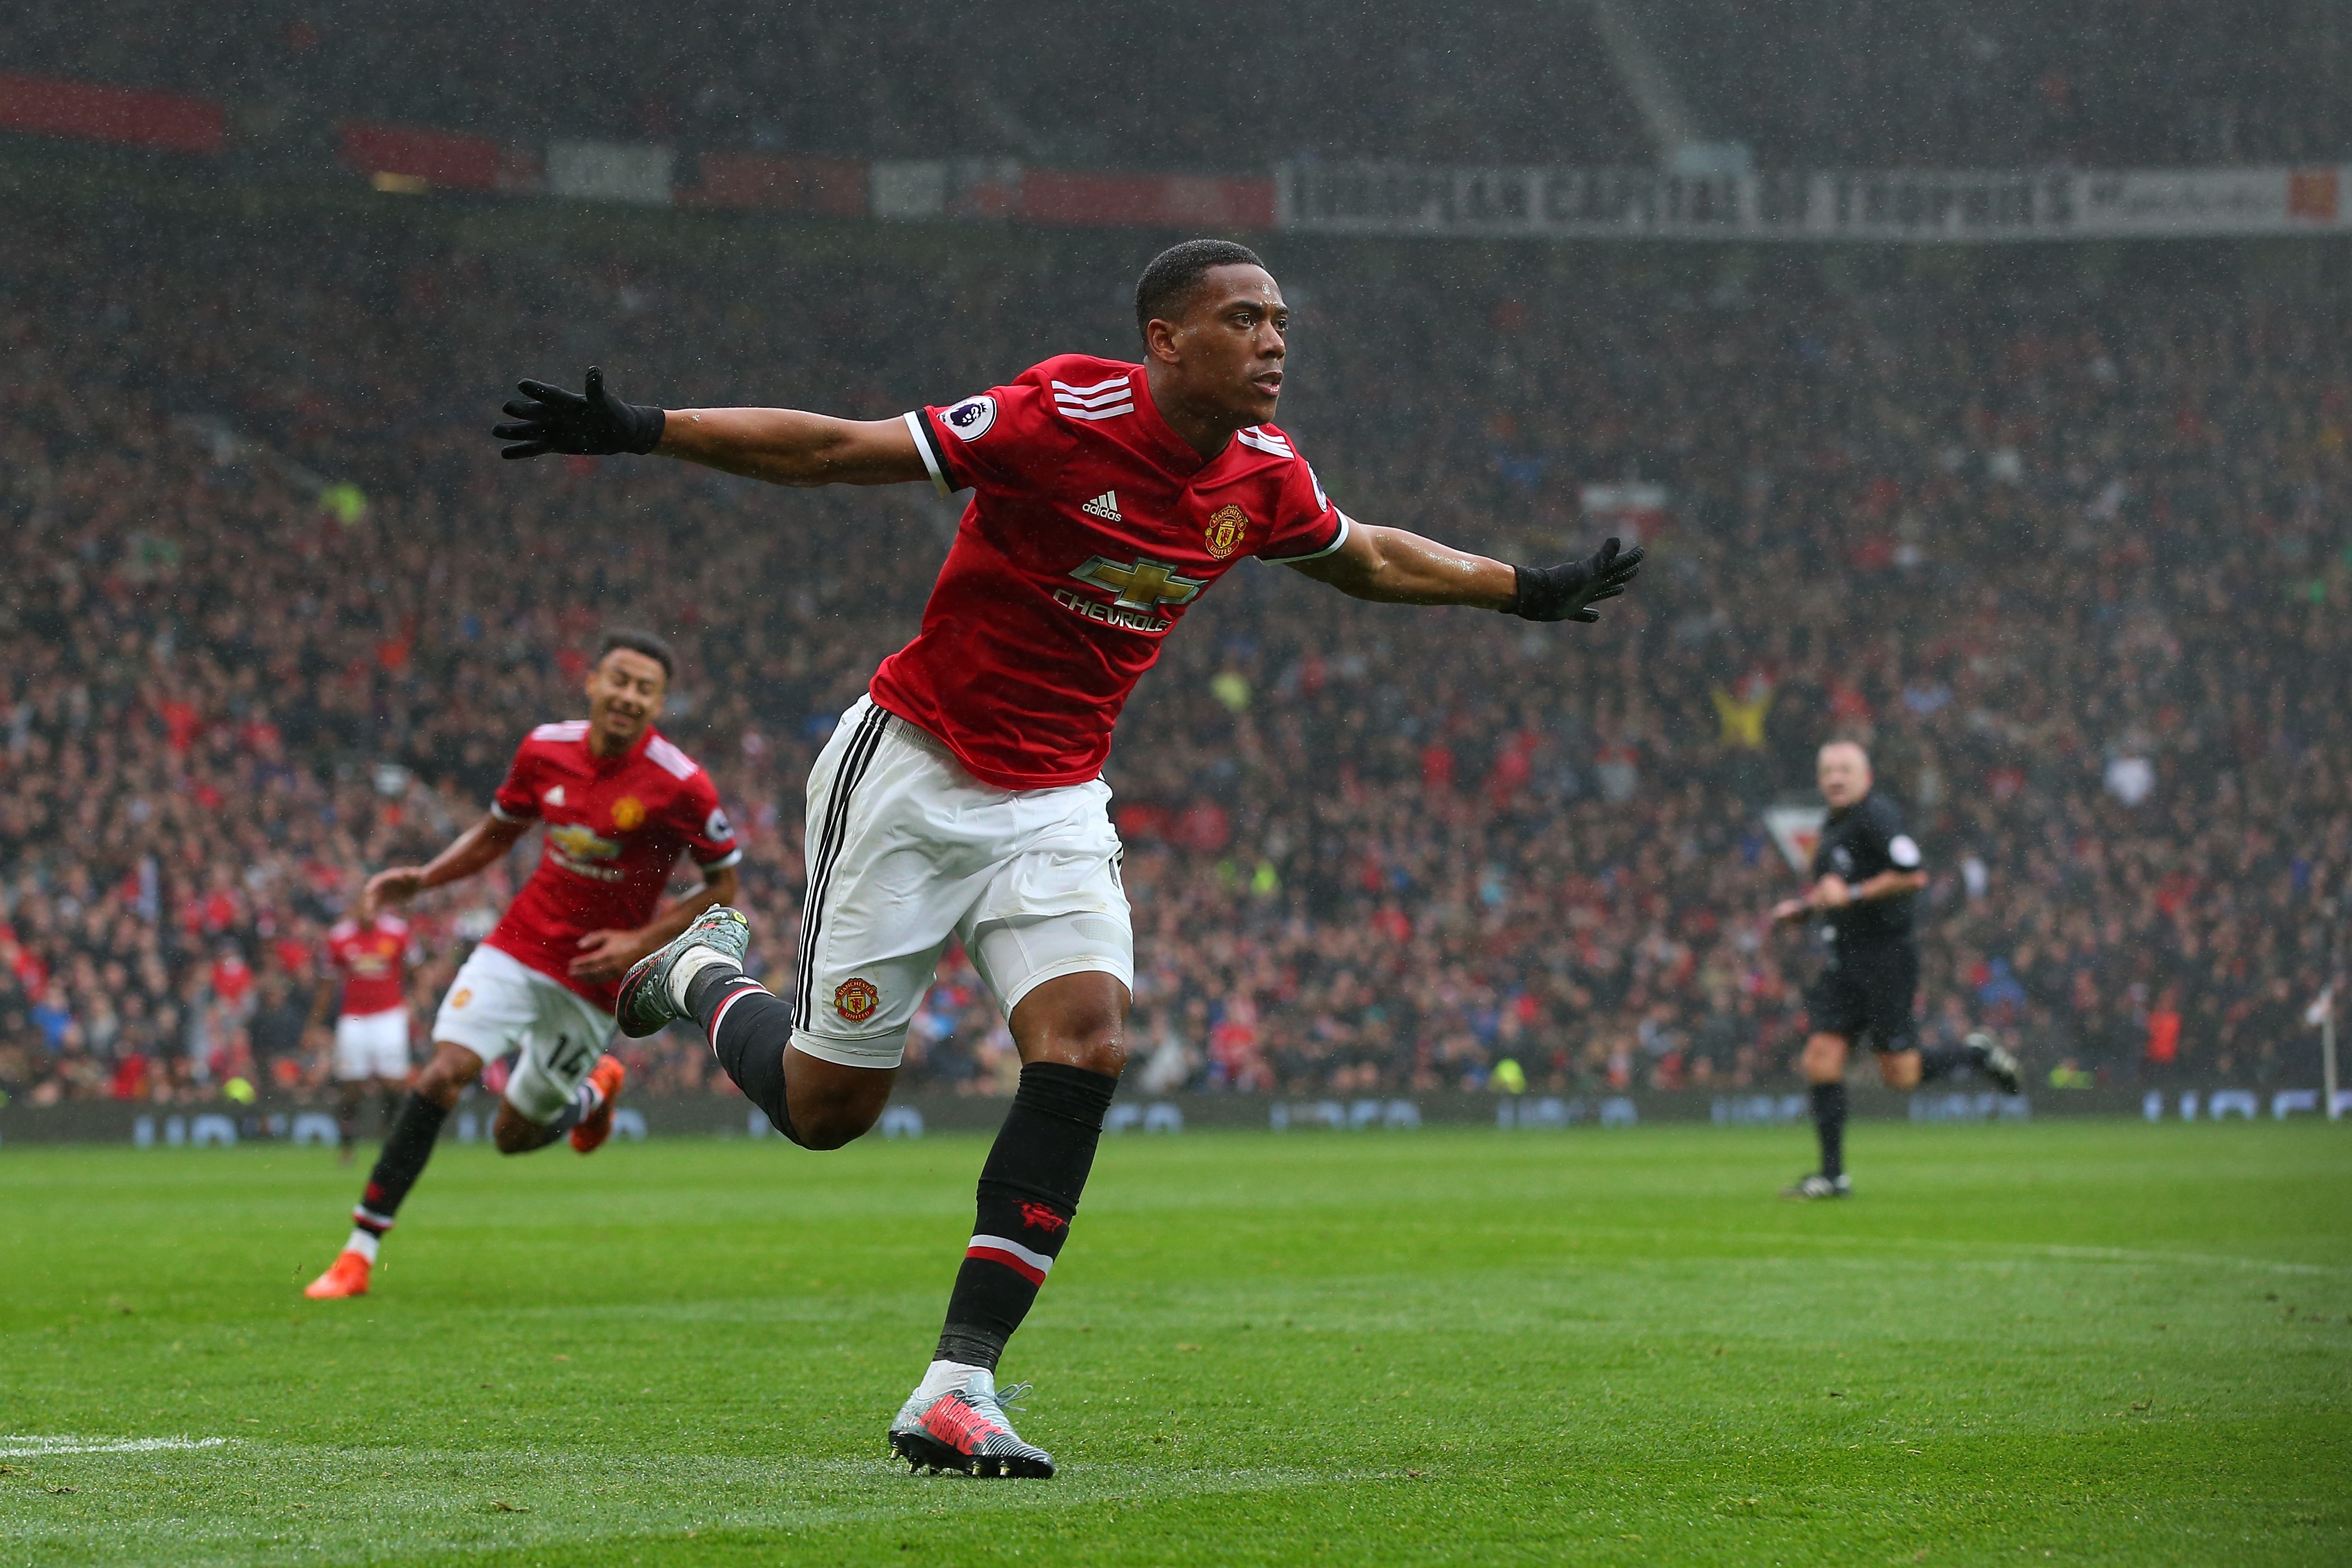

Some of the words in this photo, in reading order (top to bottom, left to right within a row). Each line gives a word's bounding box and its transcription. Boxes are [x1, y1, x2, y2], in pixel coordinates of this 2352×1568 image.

[1082, 503, 1122, 522] adidas
[1212, 508, 1244, 528] MANCHESTER
[1210, 545, 1232, 555] UNITED
[1052, 589, 1172, 632] CHEVROLE
[839, 981, 874, 996] MANCHESTER
[845, 1011, 870, 1019] UNITED
